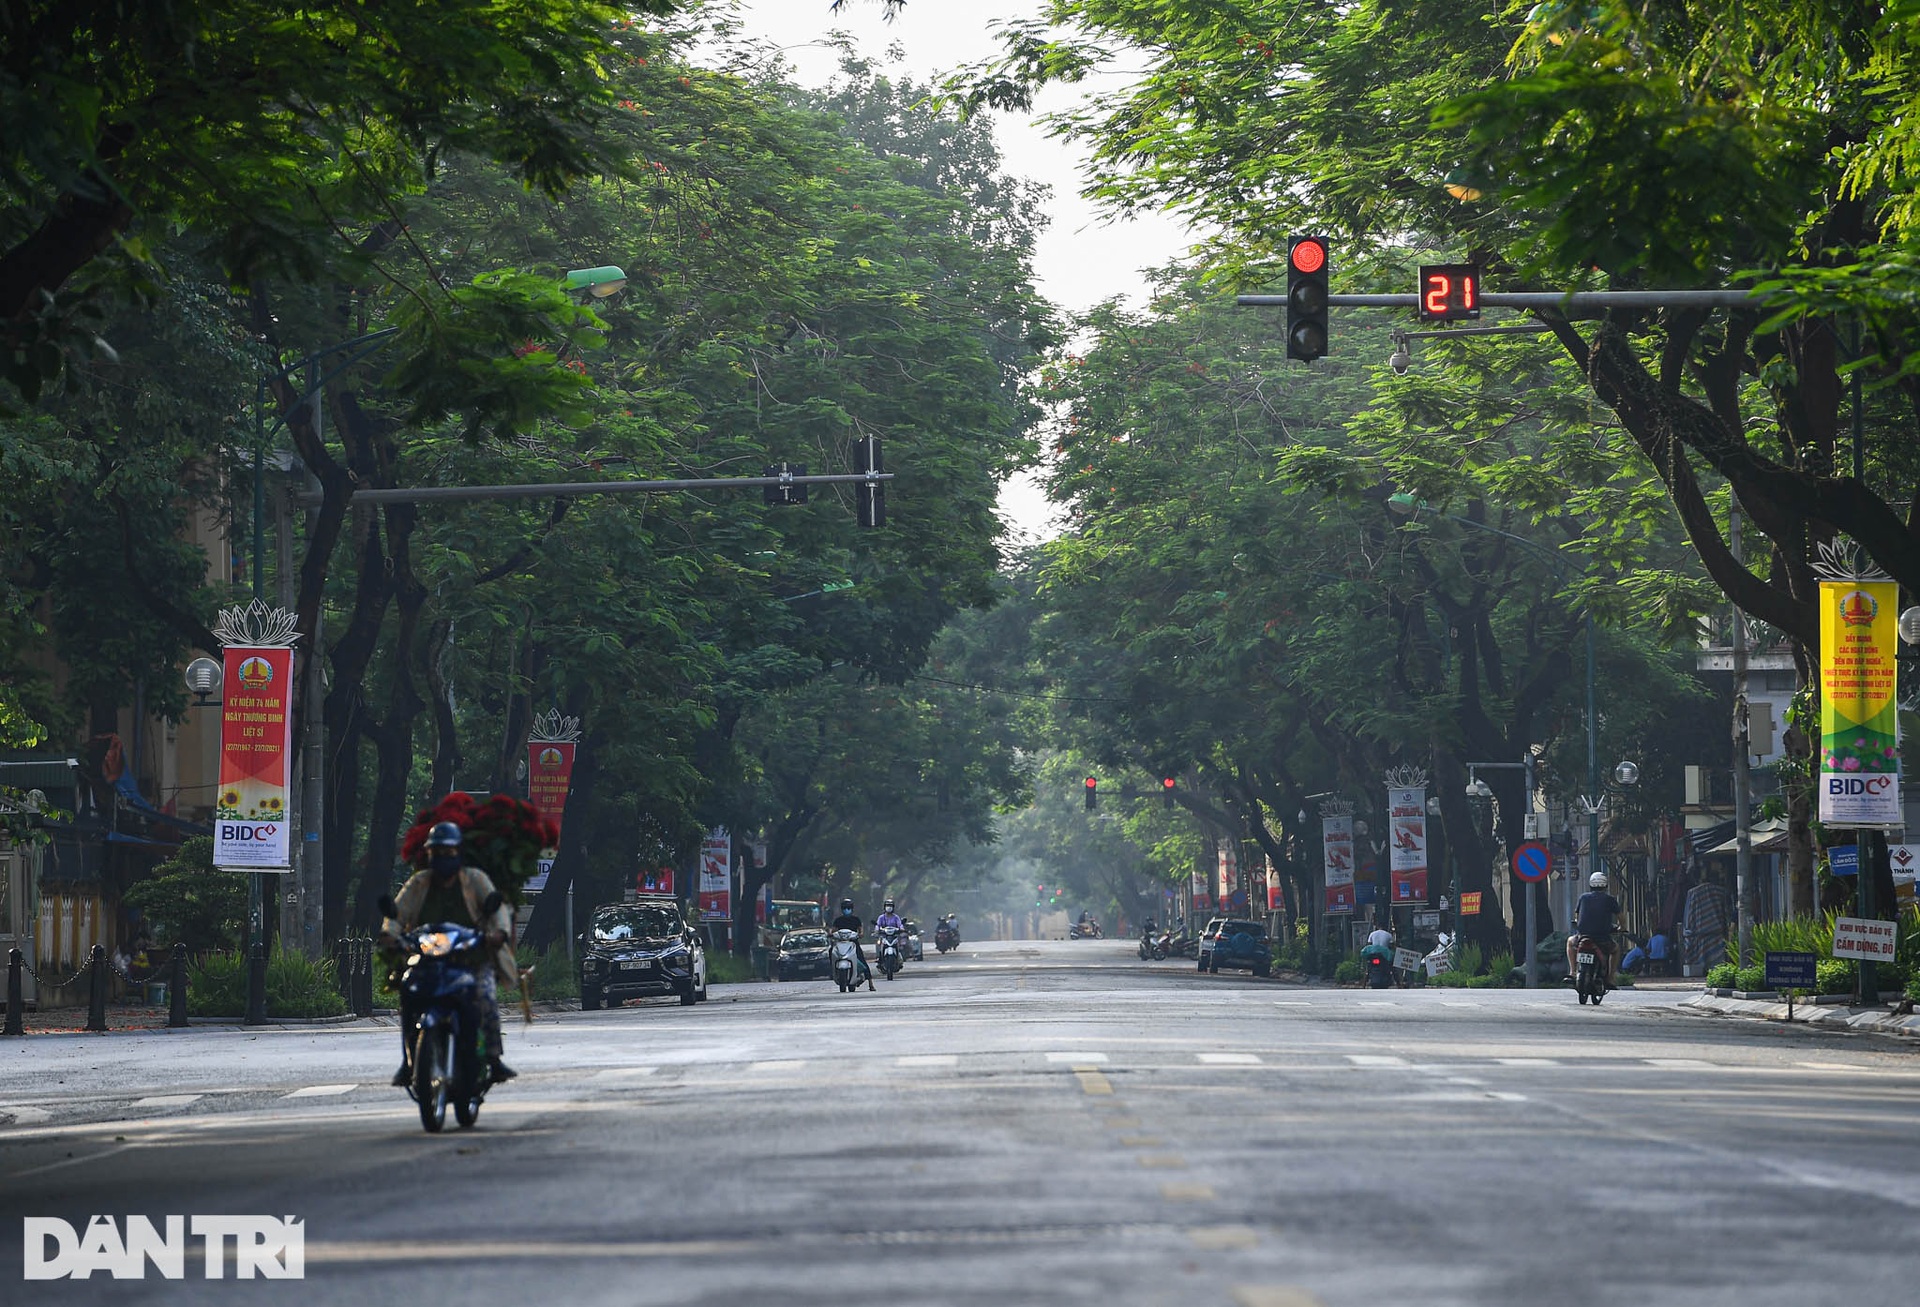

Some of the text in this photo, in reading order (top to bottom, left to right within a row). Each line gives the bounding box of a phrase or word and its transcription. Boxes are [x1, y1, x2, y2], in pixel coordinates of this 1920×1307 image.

[1427, 275, 1472, 311] 21
[1830, 778, 1880, 796] BIDC
[222, 826, 267, 841] BIDC
[1840, 924, 1853, 932] KHU
[1836, 936, 1855, 951] CẤM
